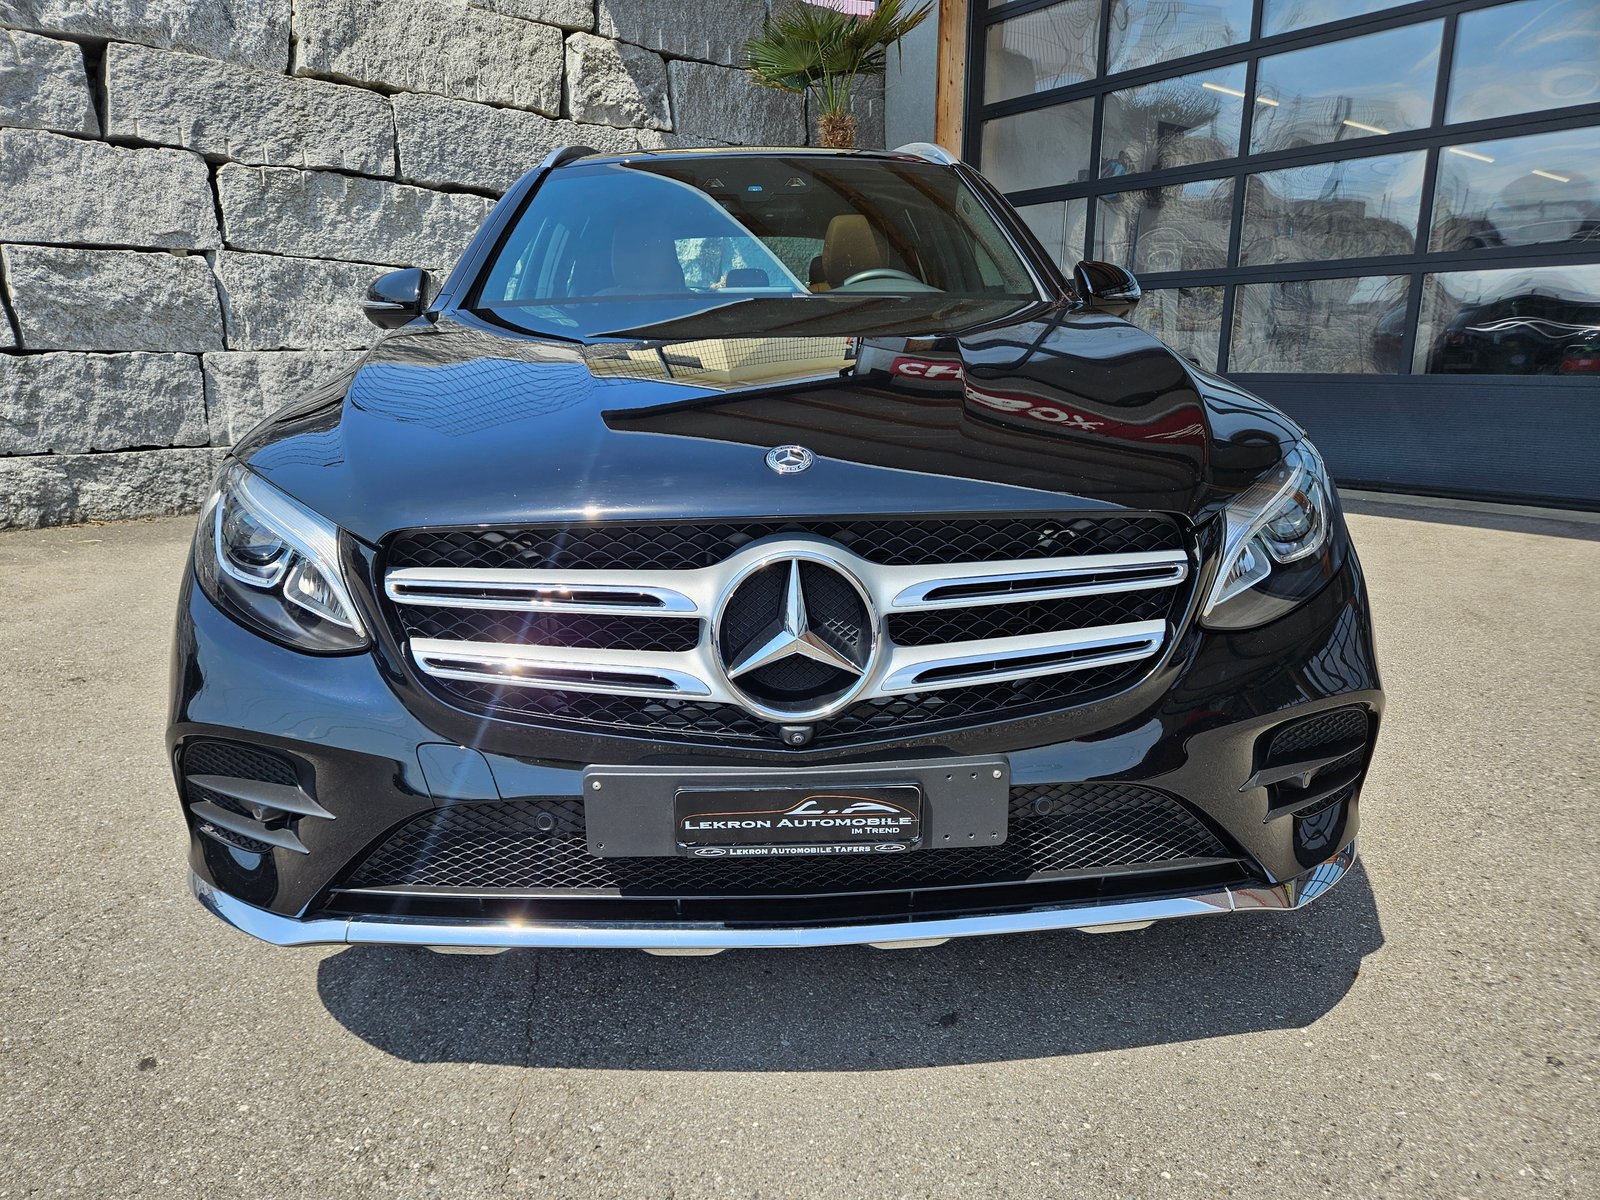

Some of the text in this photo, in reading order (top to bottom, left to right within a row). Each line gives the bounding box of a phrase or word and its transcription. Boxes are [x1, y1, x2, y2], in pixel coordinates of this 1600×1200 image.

[684, 817, 912, 830] LEKRON AUTOMOBILE
[770, 846, 832, 854] AUTOMOBILE
